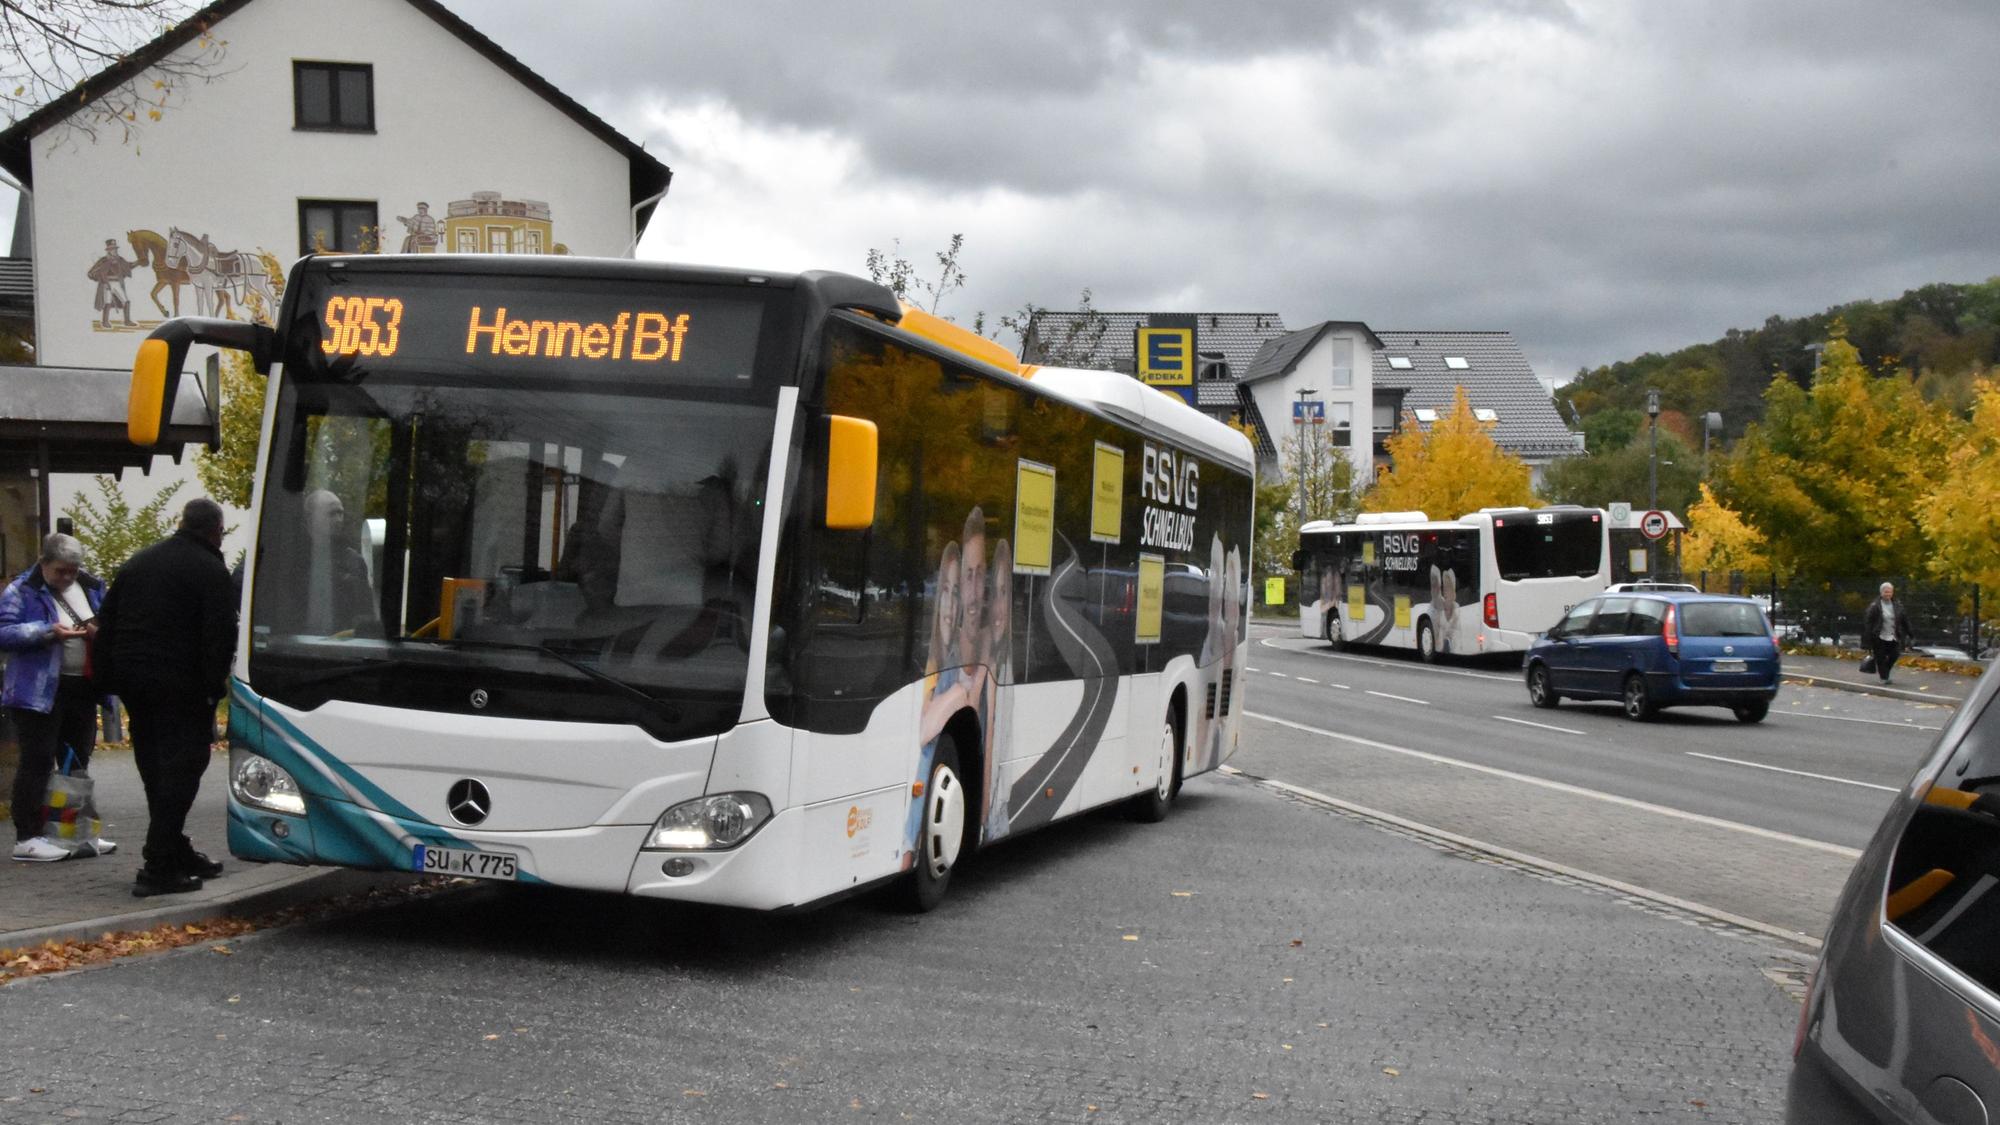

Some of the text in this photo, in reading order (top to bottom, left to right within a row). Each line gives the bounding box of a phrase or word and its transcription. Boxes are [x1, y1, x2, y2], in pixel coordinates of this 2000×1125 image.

[321, 296, 404, 358] SB53
[466, 306, 631, 360] Hennef
[1147, 373, 1184, 381] EDEKA
[1141, 440, 1200, 511] RSVG
[1140, 505, 1196, 552] SCHNELLBUS
[1383, 534, 1420, 553] RSVG
[1384, 556, 1419, 571] SCHNELLBUS
[425, 849, 450, 870] SU
[462, 853, 475, 873] K
[479, 854, 516, 877] 775
